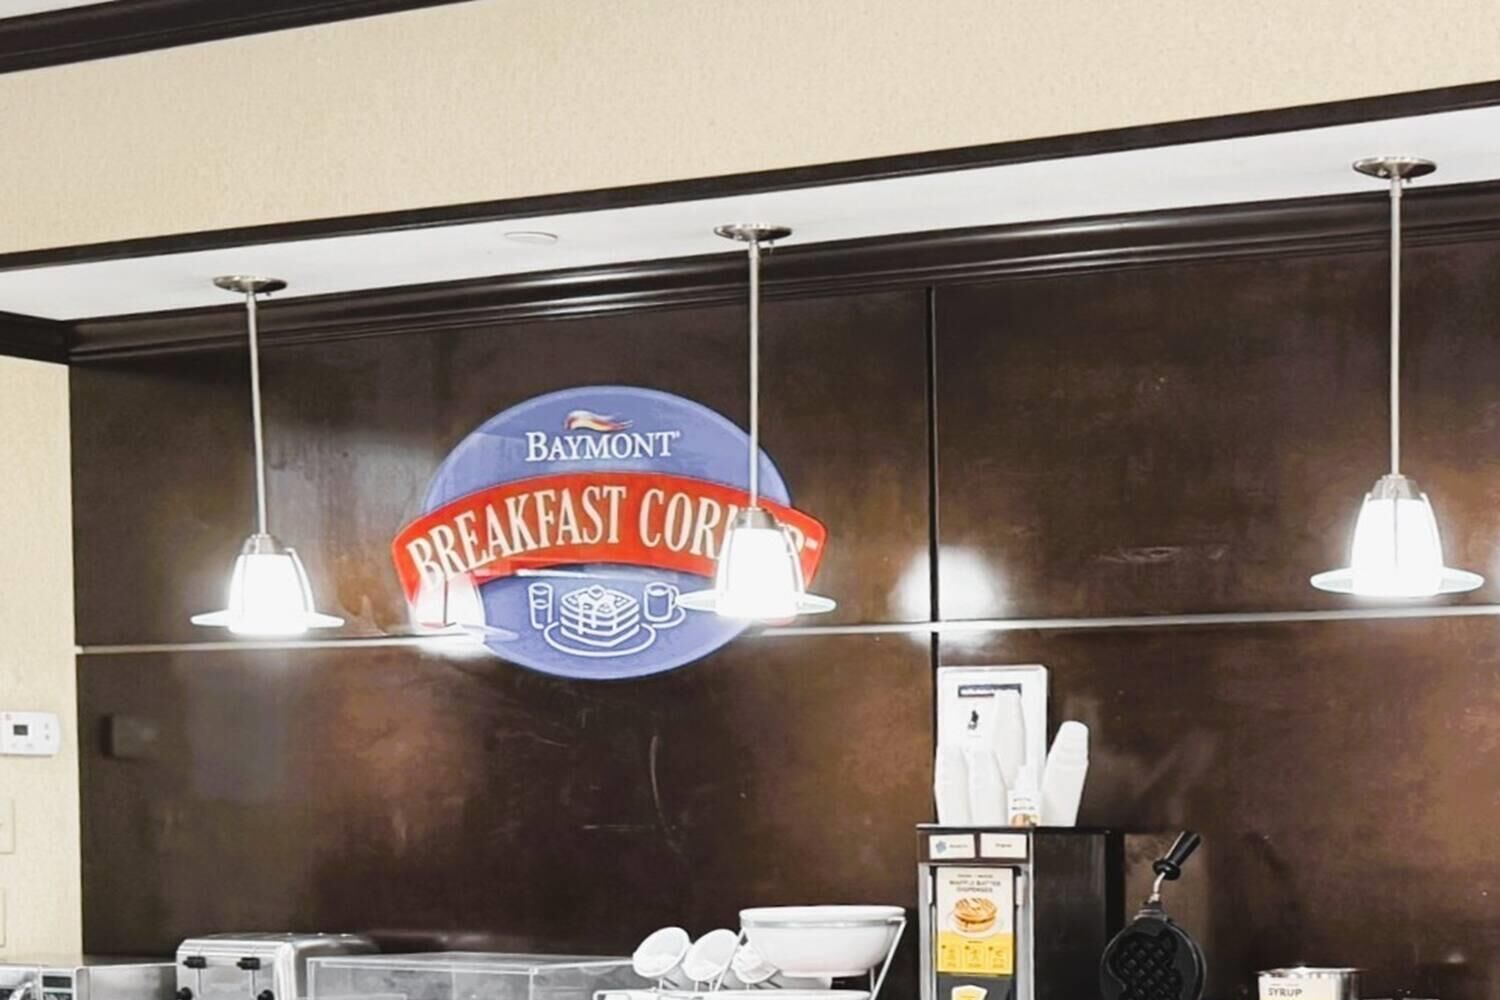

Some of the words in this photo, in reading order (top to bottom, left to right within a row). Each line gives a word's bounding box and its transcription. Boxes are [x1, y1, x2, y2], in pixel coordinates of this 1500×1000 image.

[525, 431, 677, 462] BAYMONT
[406, 485, 627, 591] BREAKFAST
[639, 487, 810, 561] COR
[1268, 987, 1303, 997] SYRUP
